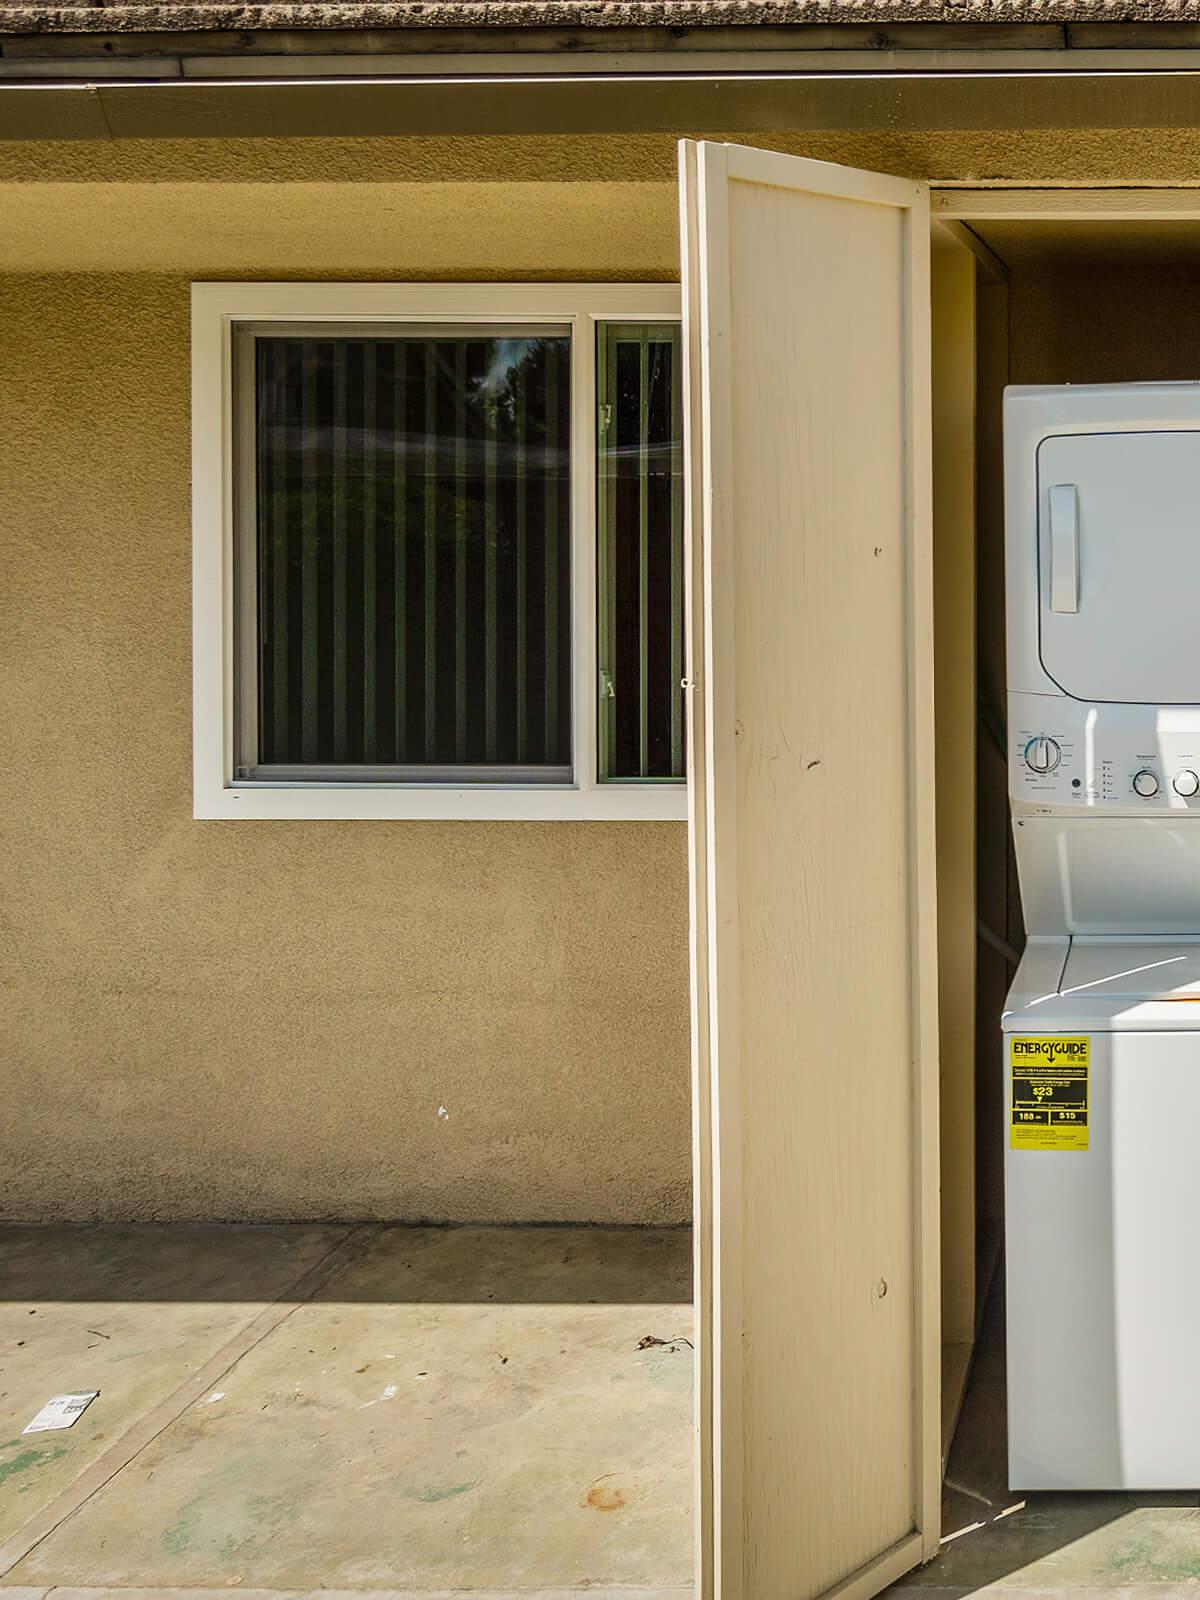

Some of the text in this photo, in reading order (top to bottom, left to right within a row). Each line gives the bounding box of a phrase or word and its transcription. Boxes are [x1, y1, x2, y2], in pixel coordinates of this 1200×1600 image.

[1014, 1042, 1087, 1054] ENERGYGUIDE
[1032, 1086, 1053, 1096] $23
[1059, 1112, 1076, 1120] $15
